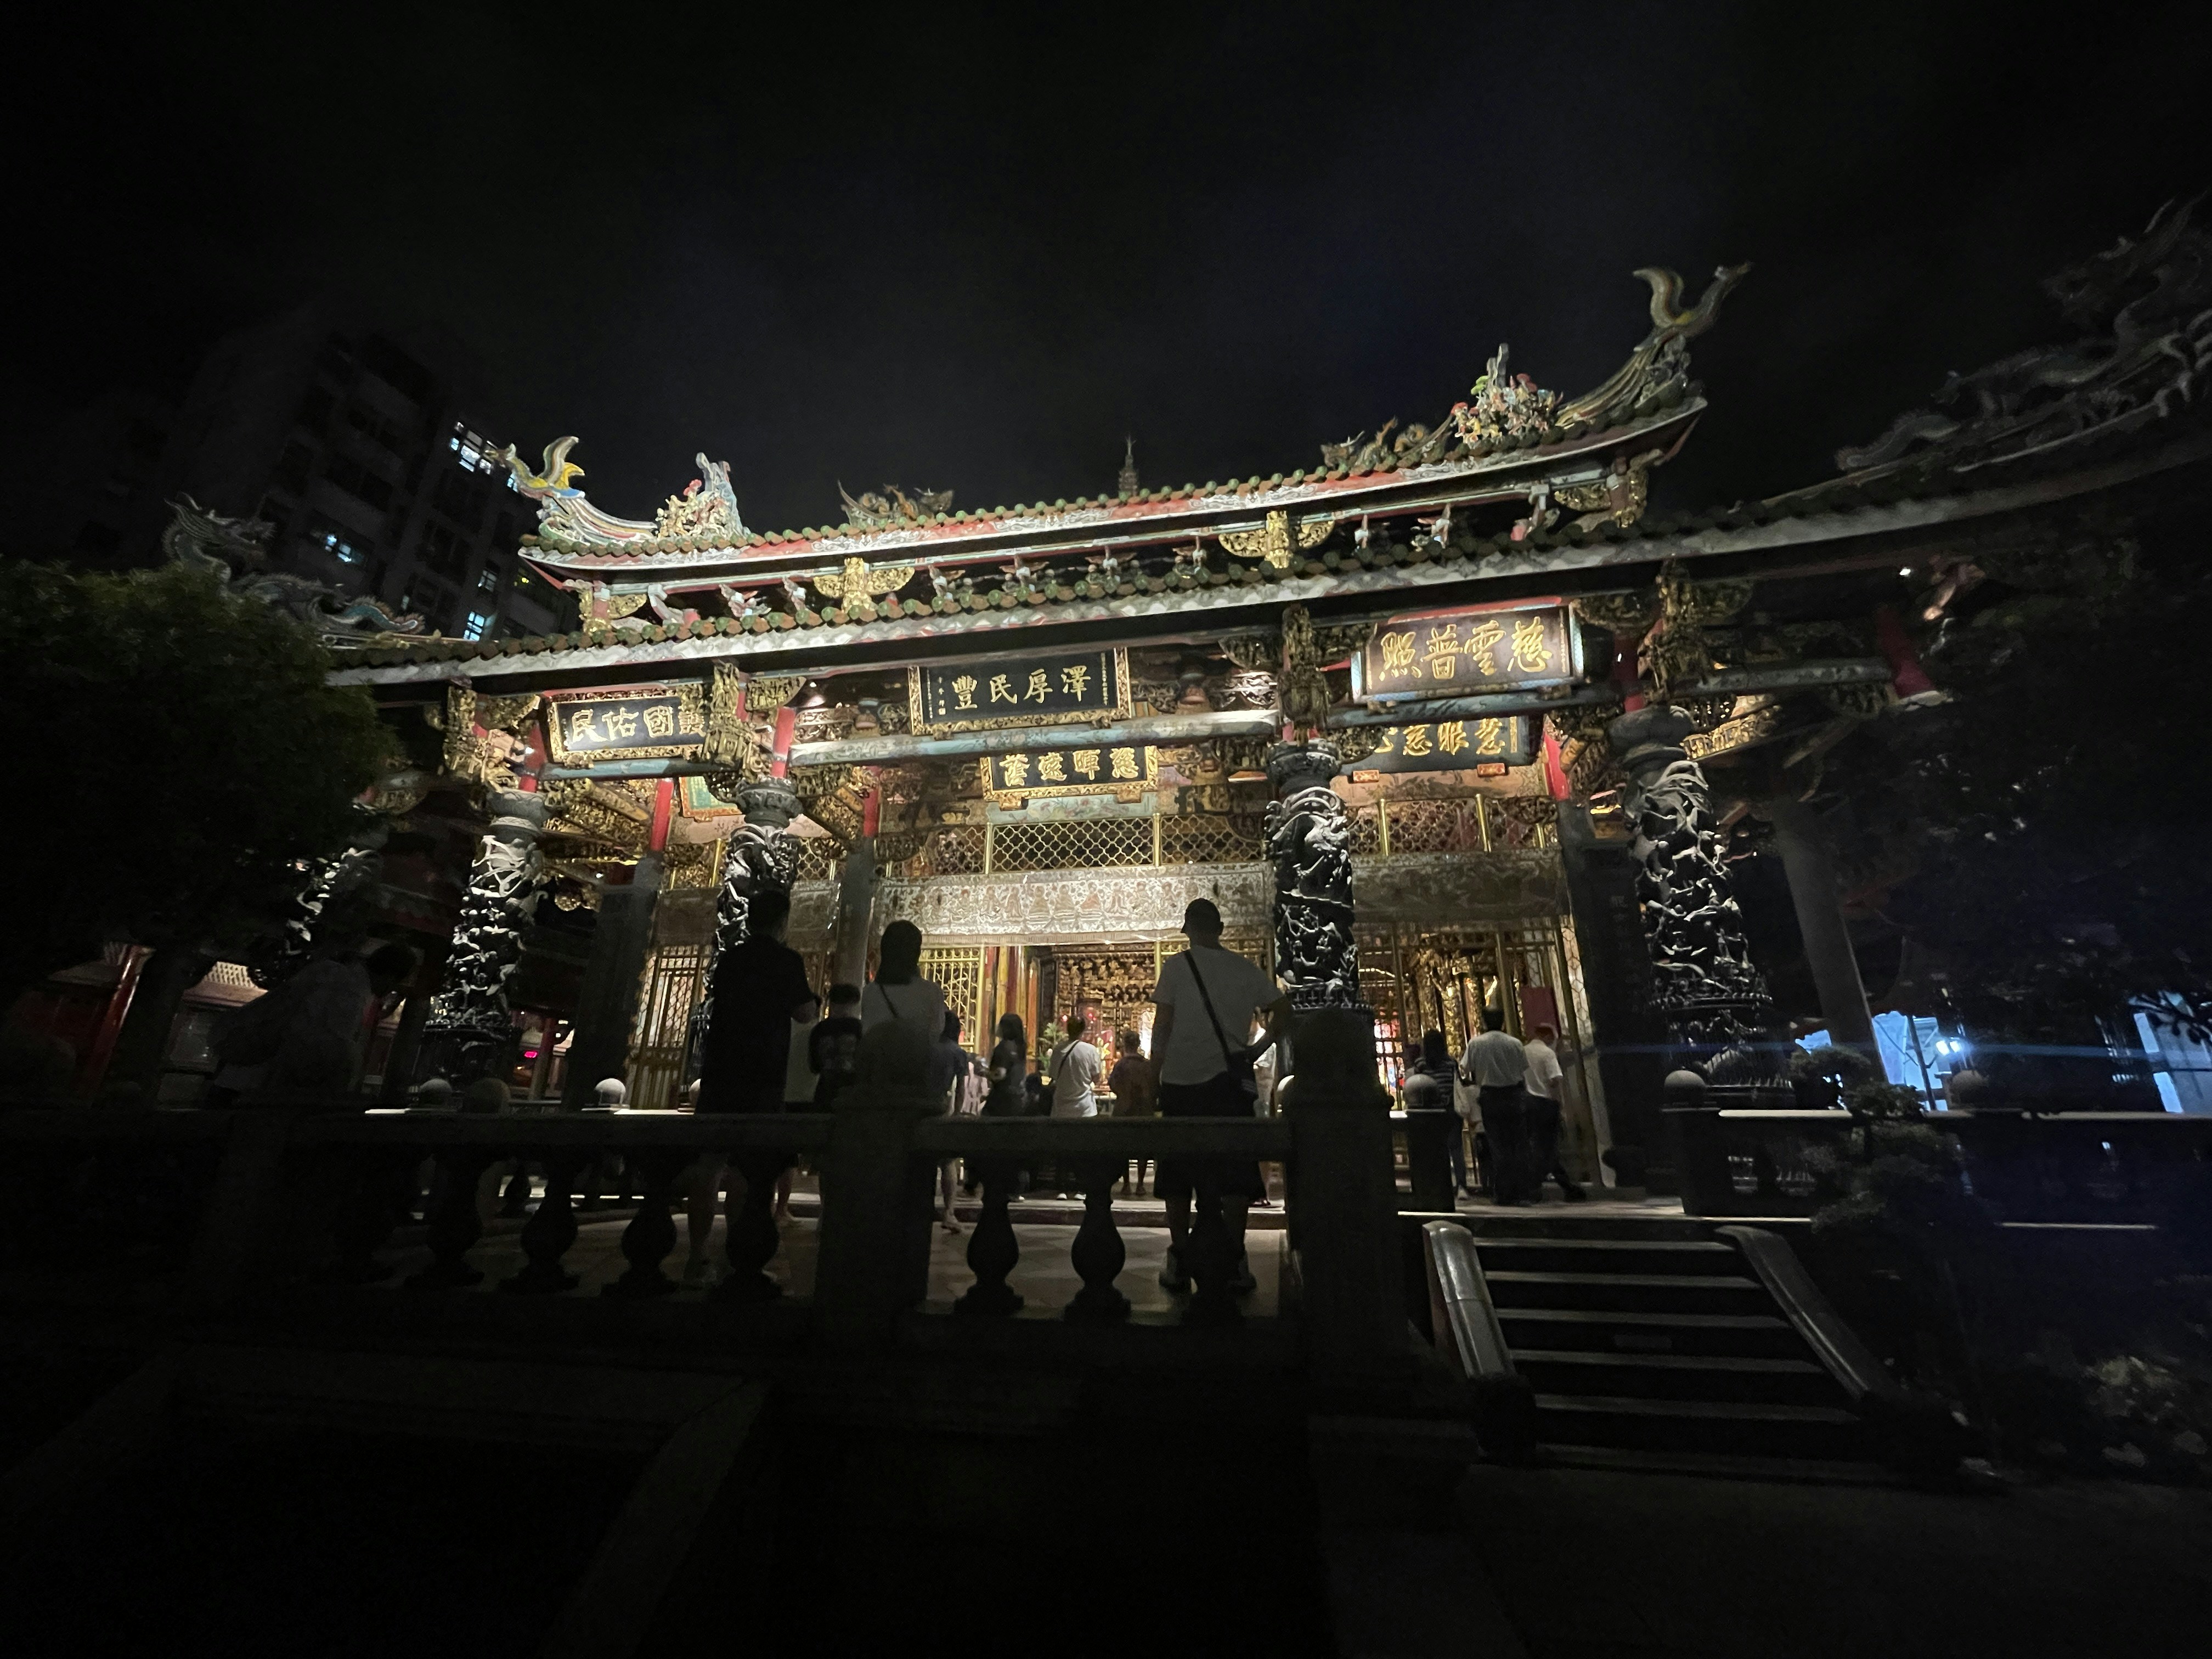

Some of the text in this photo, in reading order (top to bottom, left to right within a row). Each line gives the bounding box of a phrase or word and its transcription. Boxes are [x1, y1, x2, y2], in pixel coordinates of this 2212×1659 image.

[1379, 616, 1553, 682] 慈雲普照
[952, 665, 1091, 710] 澤厚民豐
